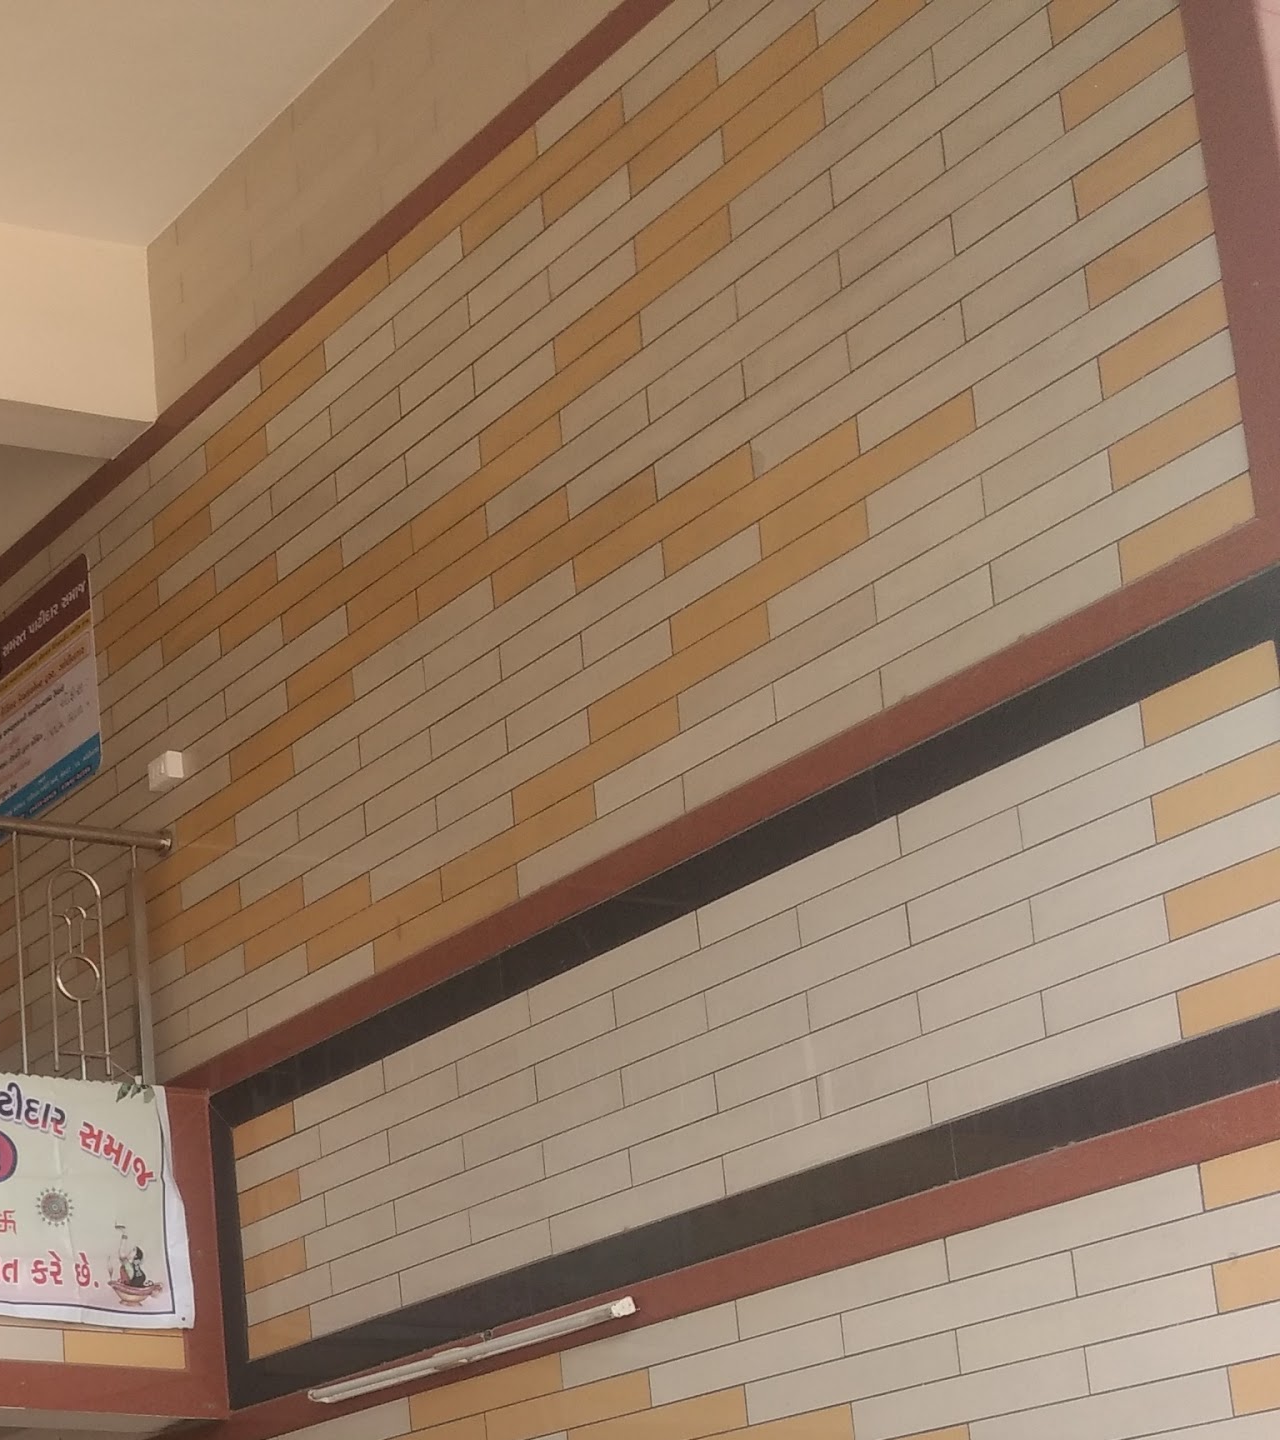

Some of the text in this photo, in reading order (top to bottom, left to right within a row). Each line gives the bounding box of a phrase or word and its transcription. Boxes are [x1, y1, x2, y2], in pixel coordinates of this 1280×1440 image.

[77, 1119, 159, 1191] સમાજ
[31, 1250, 64, 1287] કરે
[74, 1253, 101, 1289] છે.
